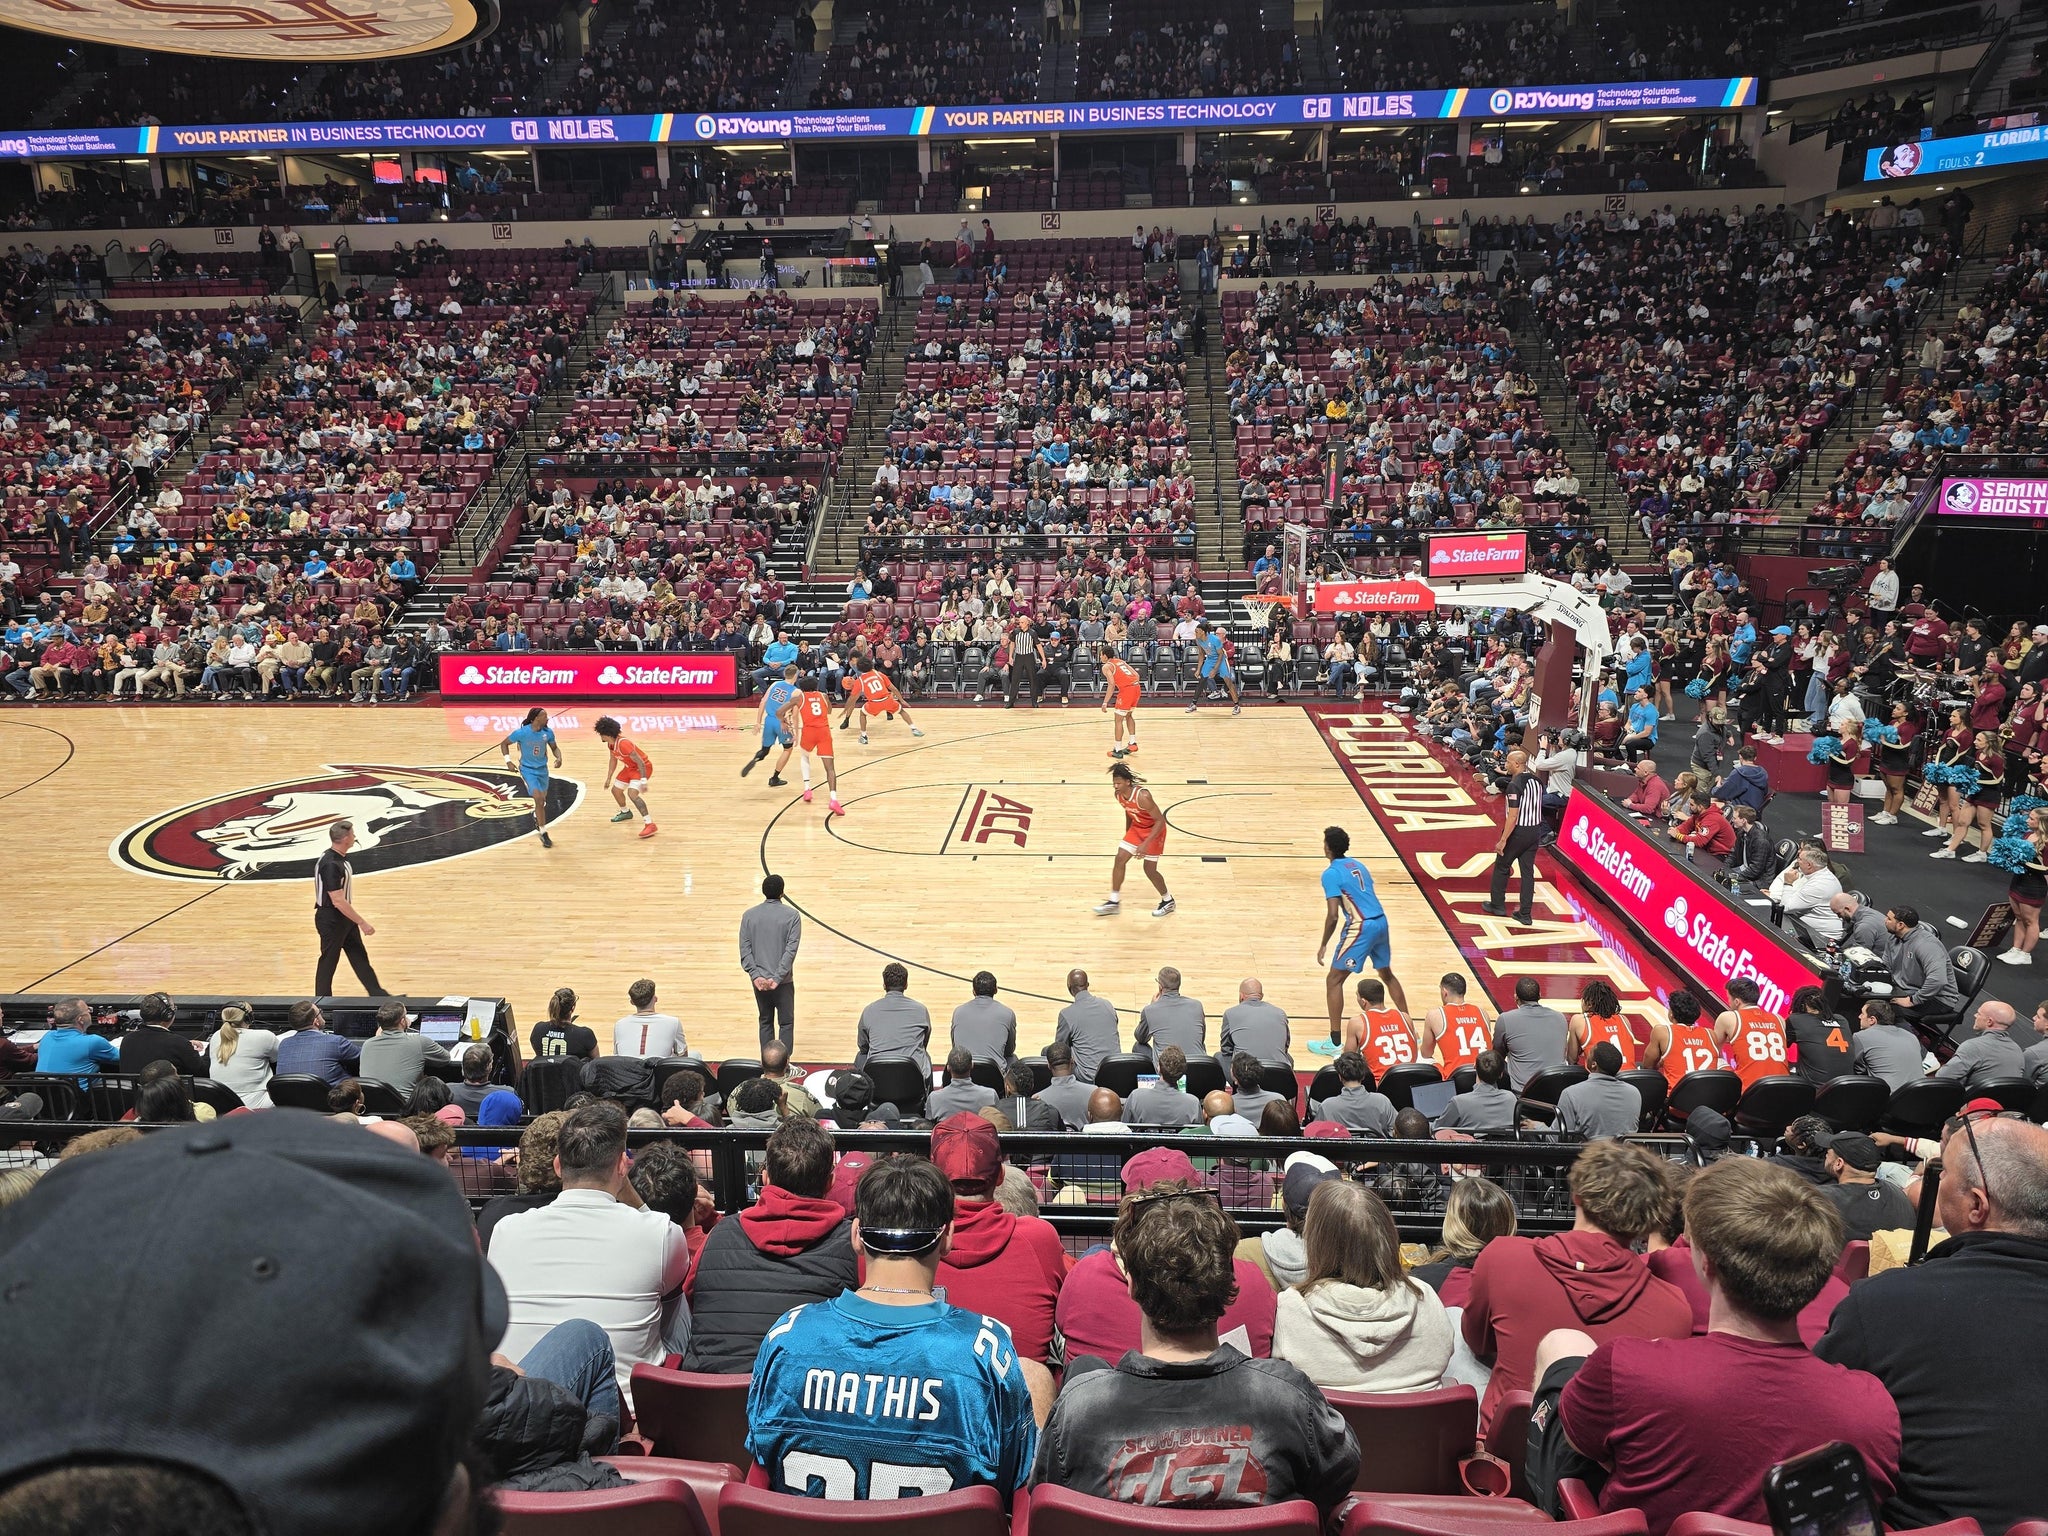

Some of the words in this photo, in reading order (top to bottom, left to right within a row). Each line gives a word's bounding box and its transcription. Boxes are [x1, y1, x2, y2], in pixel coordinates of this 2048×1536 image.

[1596, 97, 1614, 106] That
[1615, 97, 1640, 106] Power
[1641, 96, 1660, 105] Your
[1661, 94, 1696, 104] Business
[1597, 88, 1643, 98] Technology
[1643, 86, 1680, 95] Solutions
[944, 112, 988, 126] YOUR
[992, 109, 1064, 125] PARTNER
[1069, 109, 1084, 122] IN
[1089, 106, 1164, 122] BUSINESS
[1168, 103, 1277, 119] TECHNOLOGY
[1303, 98, 1331, 118] GO
[793, 116, 835, 125] Technology
[836, 115, 870, 123] Solutions
[794, 125, 811, 133] That
[812, 124, 834, 133] Power
[835, 124, 853, 132] Your
[854, 122, 886, 131] Business
[28, 135, 67, 144] Technology
[67, 134, 99, 142] Solutions
[174, 131, 217, 145] YOUR
[220, 128, 288, 144] PARTNER
[292, 128, 307, 141] IN
[311, 126, 382, 141] BUSINESS
[384, 124, 486, 139] TECHNOLOGY
[511, 121, 539, 140] GO
[1983, 129, 2041, 148] FLORIDA
[46, 143, 67, 151] Power
[68, 143, 84, 151] Your
[85, 142, 116, 150] Business
[1975, 151, 1985, 165] 2
[1317, 206, 1335, 220] 123
[1606, 196, 1625, 211] 122
[1042, 214, 1060, 229] 124
[215, 230, 233, 243] 103
[493, 224, 511, 239] 102
[1556, 604, 1585, 628] SPALDING
[771, 688, 787, 703] 25
[867, 679, 883, 694] 10
[810, 702, 822, 716] 8
[1318, 712, 1496, 832] FLORIDA
[975, 793, 1033, 848] ACC
[1831, 805, 1849, 849] DEFENSE
[1351, 869, 1366, 892] 7
[1973, 901, 2012, 948] DEFENSE
[1380, 1023, 1399, 1033] ALLEN
[541, 1037, 567, 1056] 10
[1375, 1034, 1412, 1066] 35
[1455, 1026, 1488, 1056] 14
[1746, 1031, 1786, 1062] 88
[1826, 1028, 1849, 1053] 4
[1682, 1048, 1714, 1074] 12
[803, 1368, 943, 1421] MATHIS
[1124, 1430, 1175, 1454] SLOW
